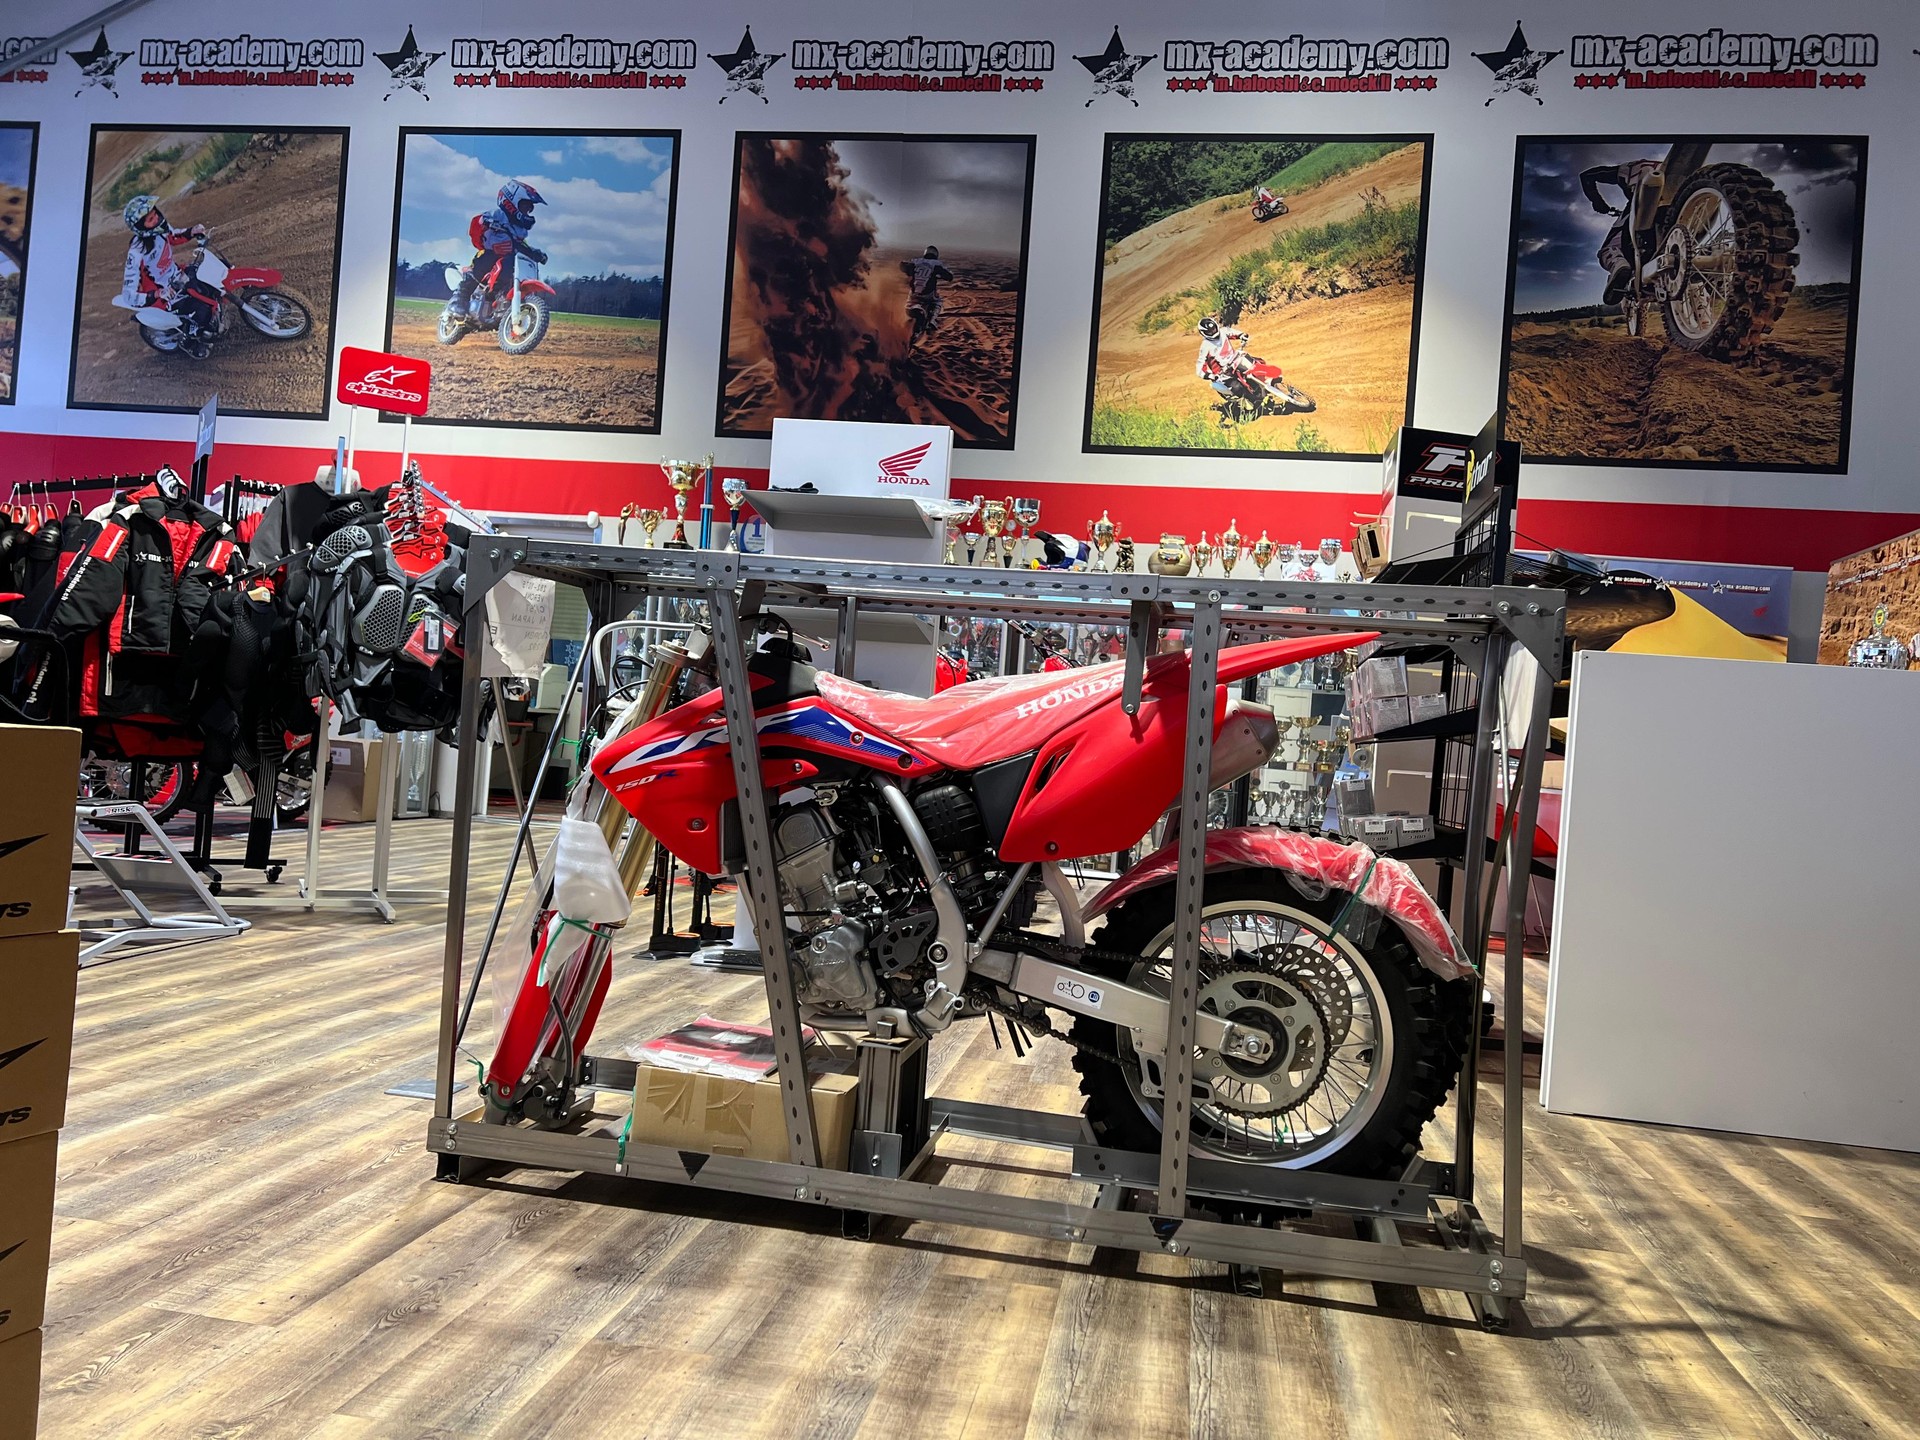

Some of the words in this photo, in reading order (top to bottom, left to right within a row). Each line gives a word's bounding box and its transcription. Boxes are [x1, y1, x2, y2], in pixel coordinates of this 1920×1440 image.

[140, 34, 364, 72] mx-academy.com
[451, 34, 697, 74] mx-academy.com
[792, 36, 1054, 77] mx-academy.com
[1163, 34, 1450, 77] mx-academy.com
[1571, 28, 1878, 72] mx-academy.com
[345, 381, 422, 402] alpinestars
[877, 475, 931, 486] HONDA
[1469, 451, 1493, 491] thor
[1014, 671, 1125, 719] HONDA
[615, 768, 679, 792] 150R
